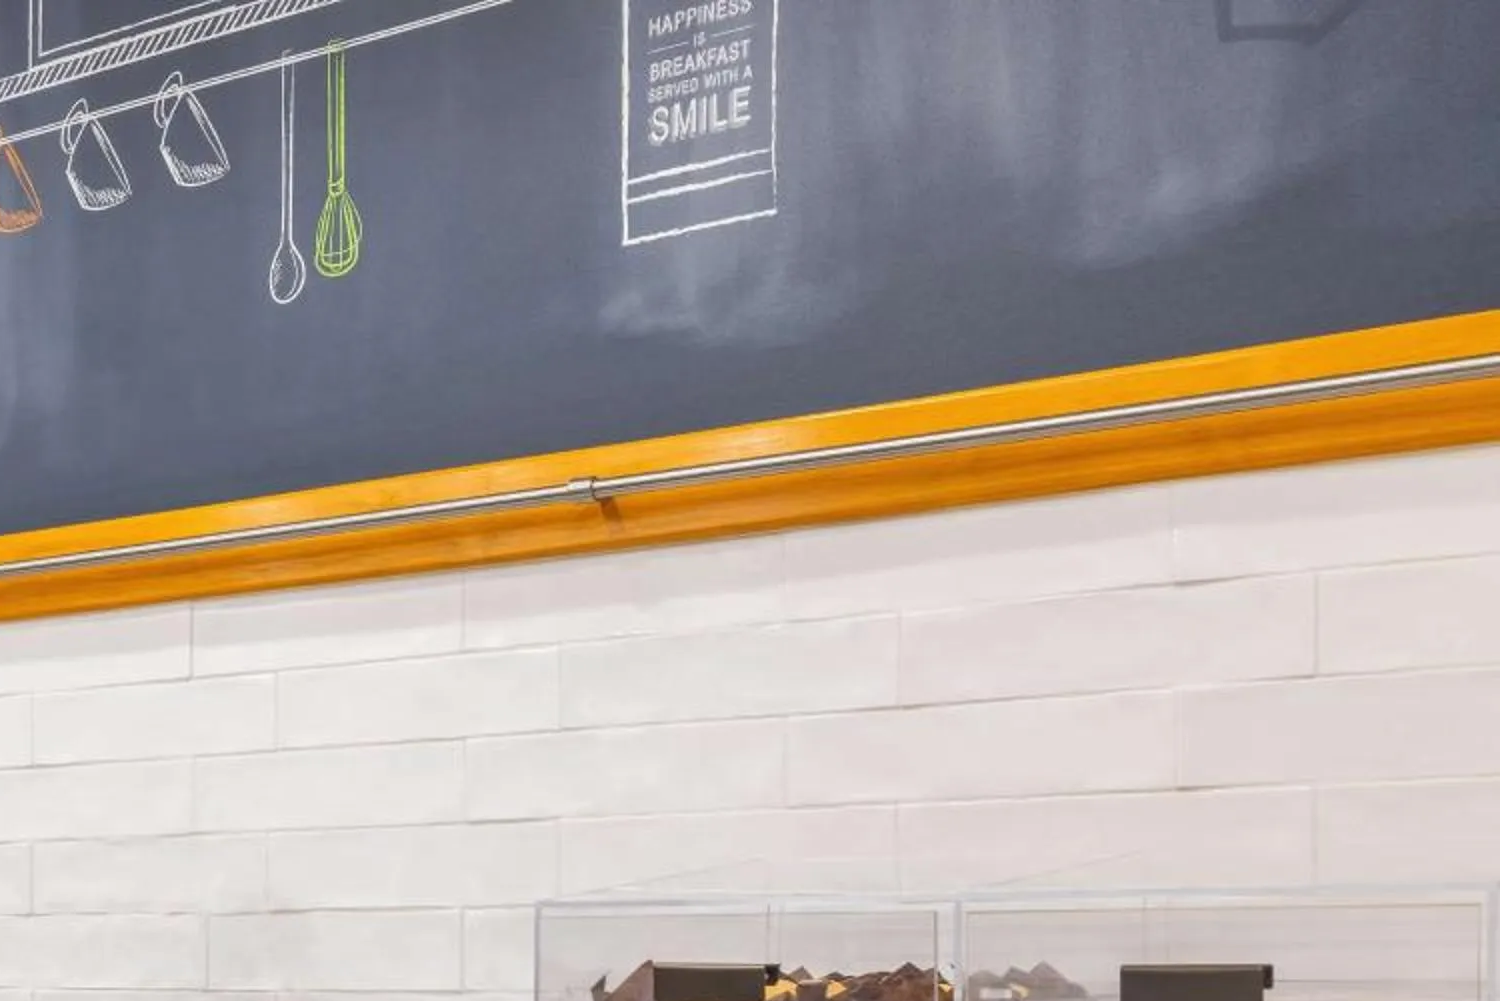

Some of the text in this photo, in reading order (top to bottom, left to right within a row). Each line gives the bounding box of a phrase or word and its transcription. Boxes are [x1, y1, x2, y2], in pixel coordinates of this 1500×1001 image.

[648, 0, 752, 37] HAPPINESS
[693, 31, 706, 48] IS
[649, 39, 751, 82] BREAKFAST
[649, 65, 753, 102] SERVED WITH A
[649, 85, 752, 146] SMILE
